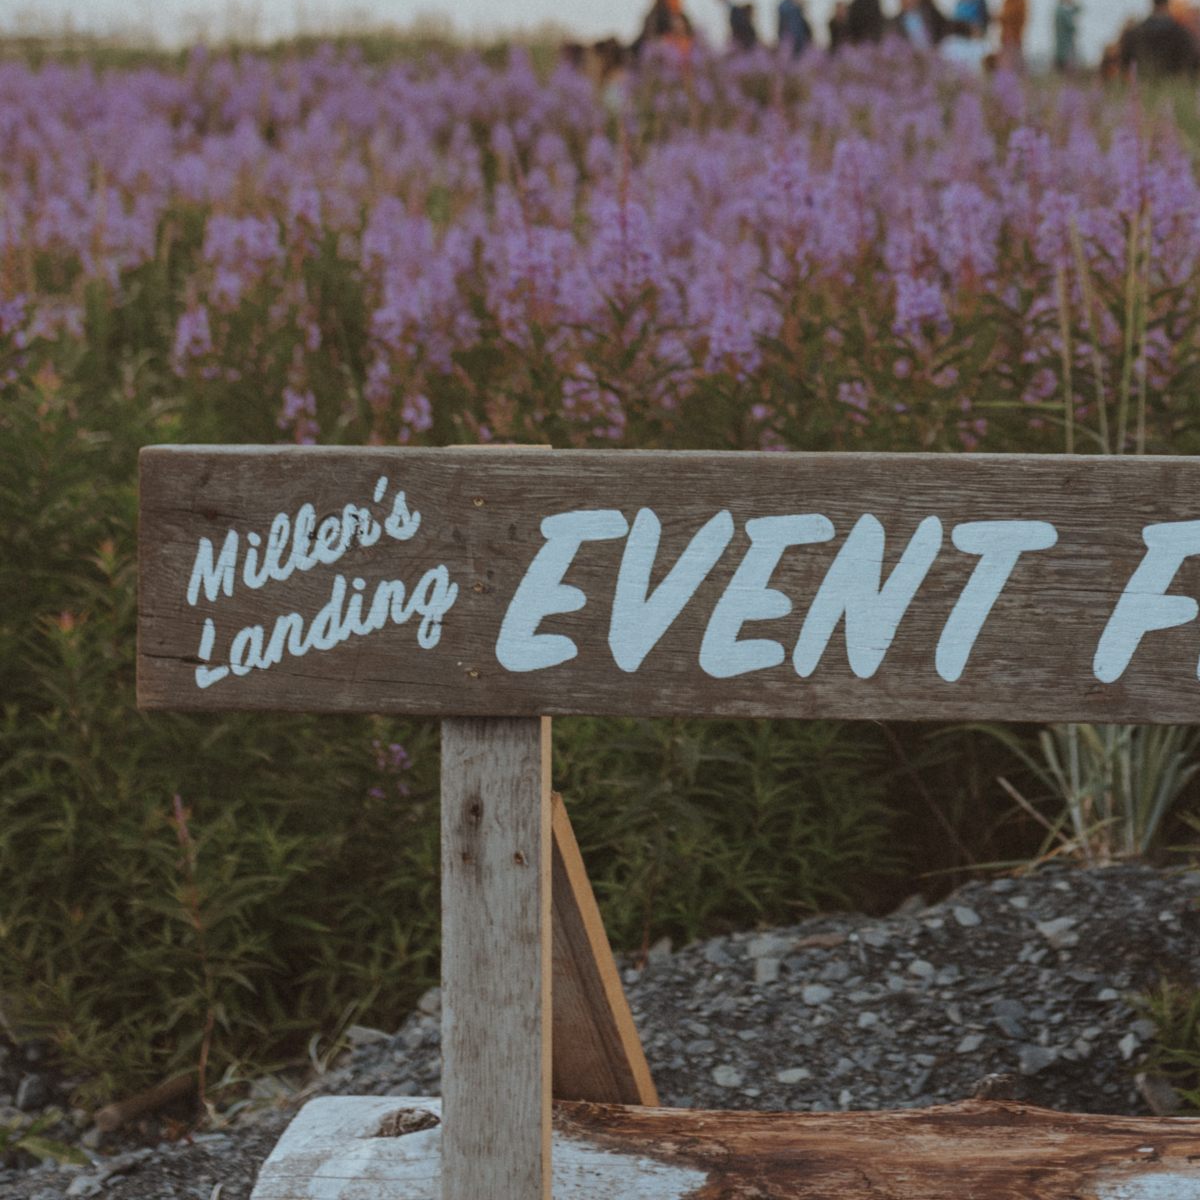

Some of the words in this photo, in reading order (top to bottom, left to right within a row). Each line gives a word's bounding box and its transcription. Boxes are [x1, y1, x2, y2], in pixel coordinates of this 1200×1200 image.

[187, 476, 421, 606] Miller's
[495, 507, 1058, 682] EVENT
[195, 564, 459, 689] Landing
